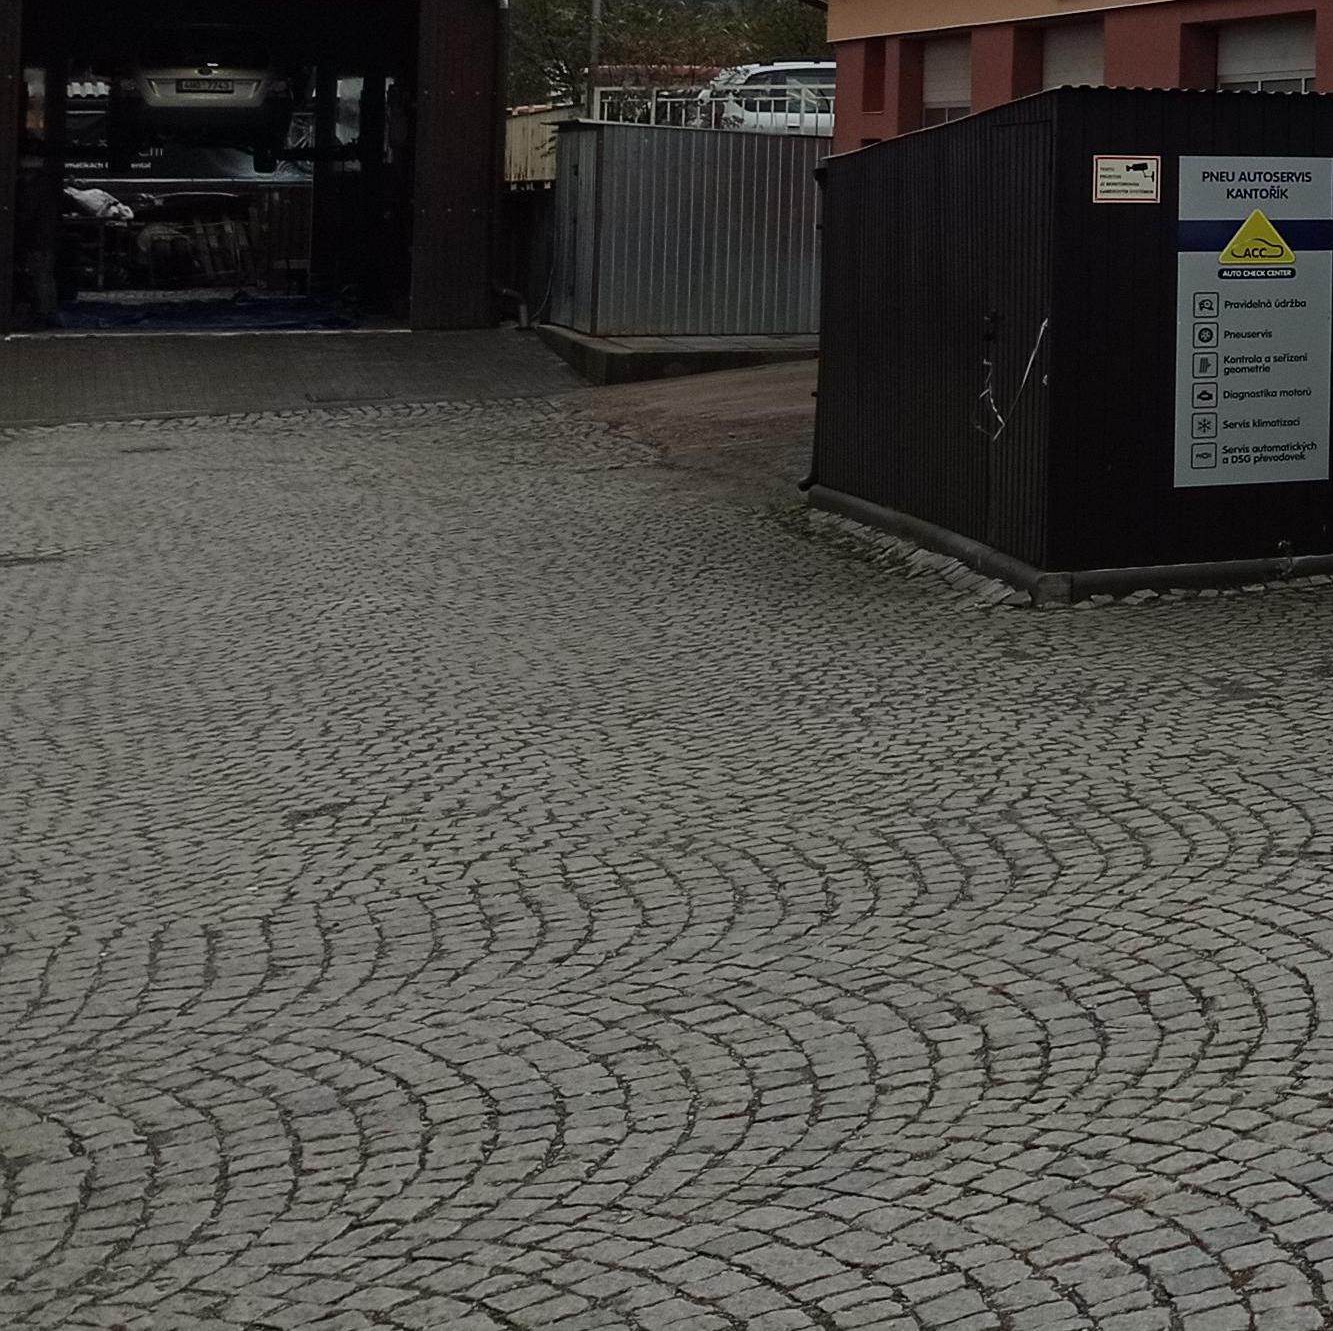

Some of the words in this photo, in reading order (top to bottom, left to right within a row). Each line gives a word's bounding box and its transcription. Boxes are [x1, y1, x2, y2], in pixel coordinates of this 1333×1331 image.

[1202, 171, 1235, 182] PNEU
[1238, 171, 1312, 183] AUTOSERVIS
[1226, 185, 1289, 200] KANTOŘÍK
[1243, 247, 1268, 259] ACC
[1222, 269, 1241, 278] AUTO
[1243, 269, 1265, 277] CHECK
[1266, 269, 1293, 277] CENTER
[1224, 299, 1272, 310] Pravidelná
[1274, 298, 1307, 309] údržba
[1224, 329, 1273, 339] Pneuservis
[1223, 355, 1262, 364] Kontrola
[1223, 364, 1271, 376] geometrie
[1223, 388, 1277, 401] Diagnostika
[1222, 419, 1250, 429] Servis
[1222, 444, 1250, 454] Servis
[1252, 441, 1317, 453] automatických
[1222, 456, 1229, 464] a
[1231, 454, 1251, 464] DSG
[1253, 452, 1306, 465] převodovek
